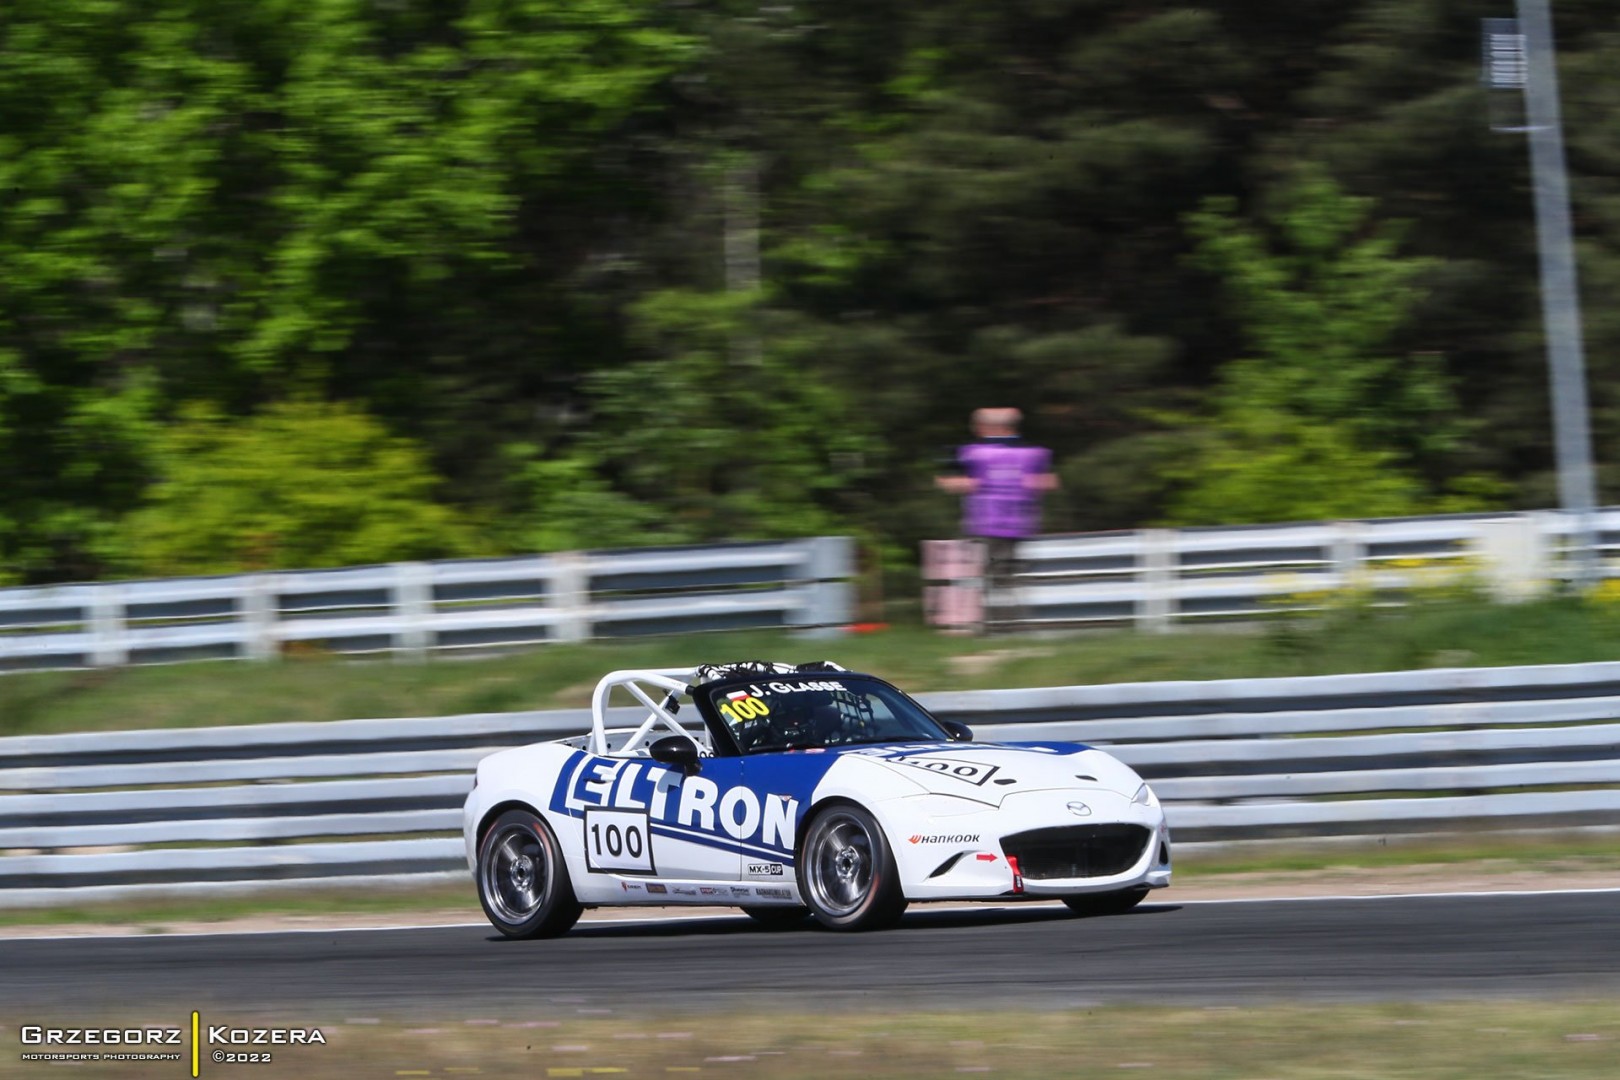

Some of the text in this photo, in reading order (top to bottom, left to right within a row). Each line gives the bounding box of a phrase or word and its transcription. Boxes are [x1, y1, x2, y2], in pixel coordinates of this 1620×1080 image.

[749, 681, 847, 698] J. GLASSE
[720, 697, 770, 722] 100
[565, 755, 799, 850] ELTRON
[591, 823, 643, 858] 100
[748, 864, 783, 875] MX-5 CUP
